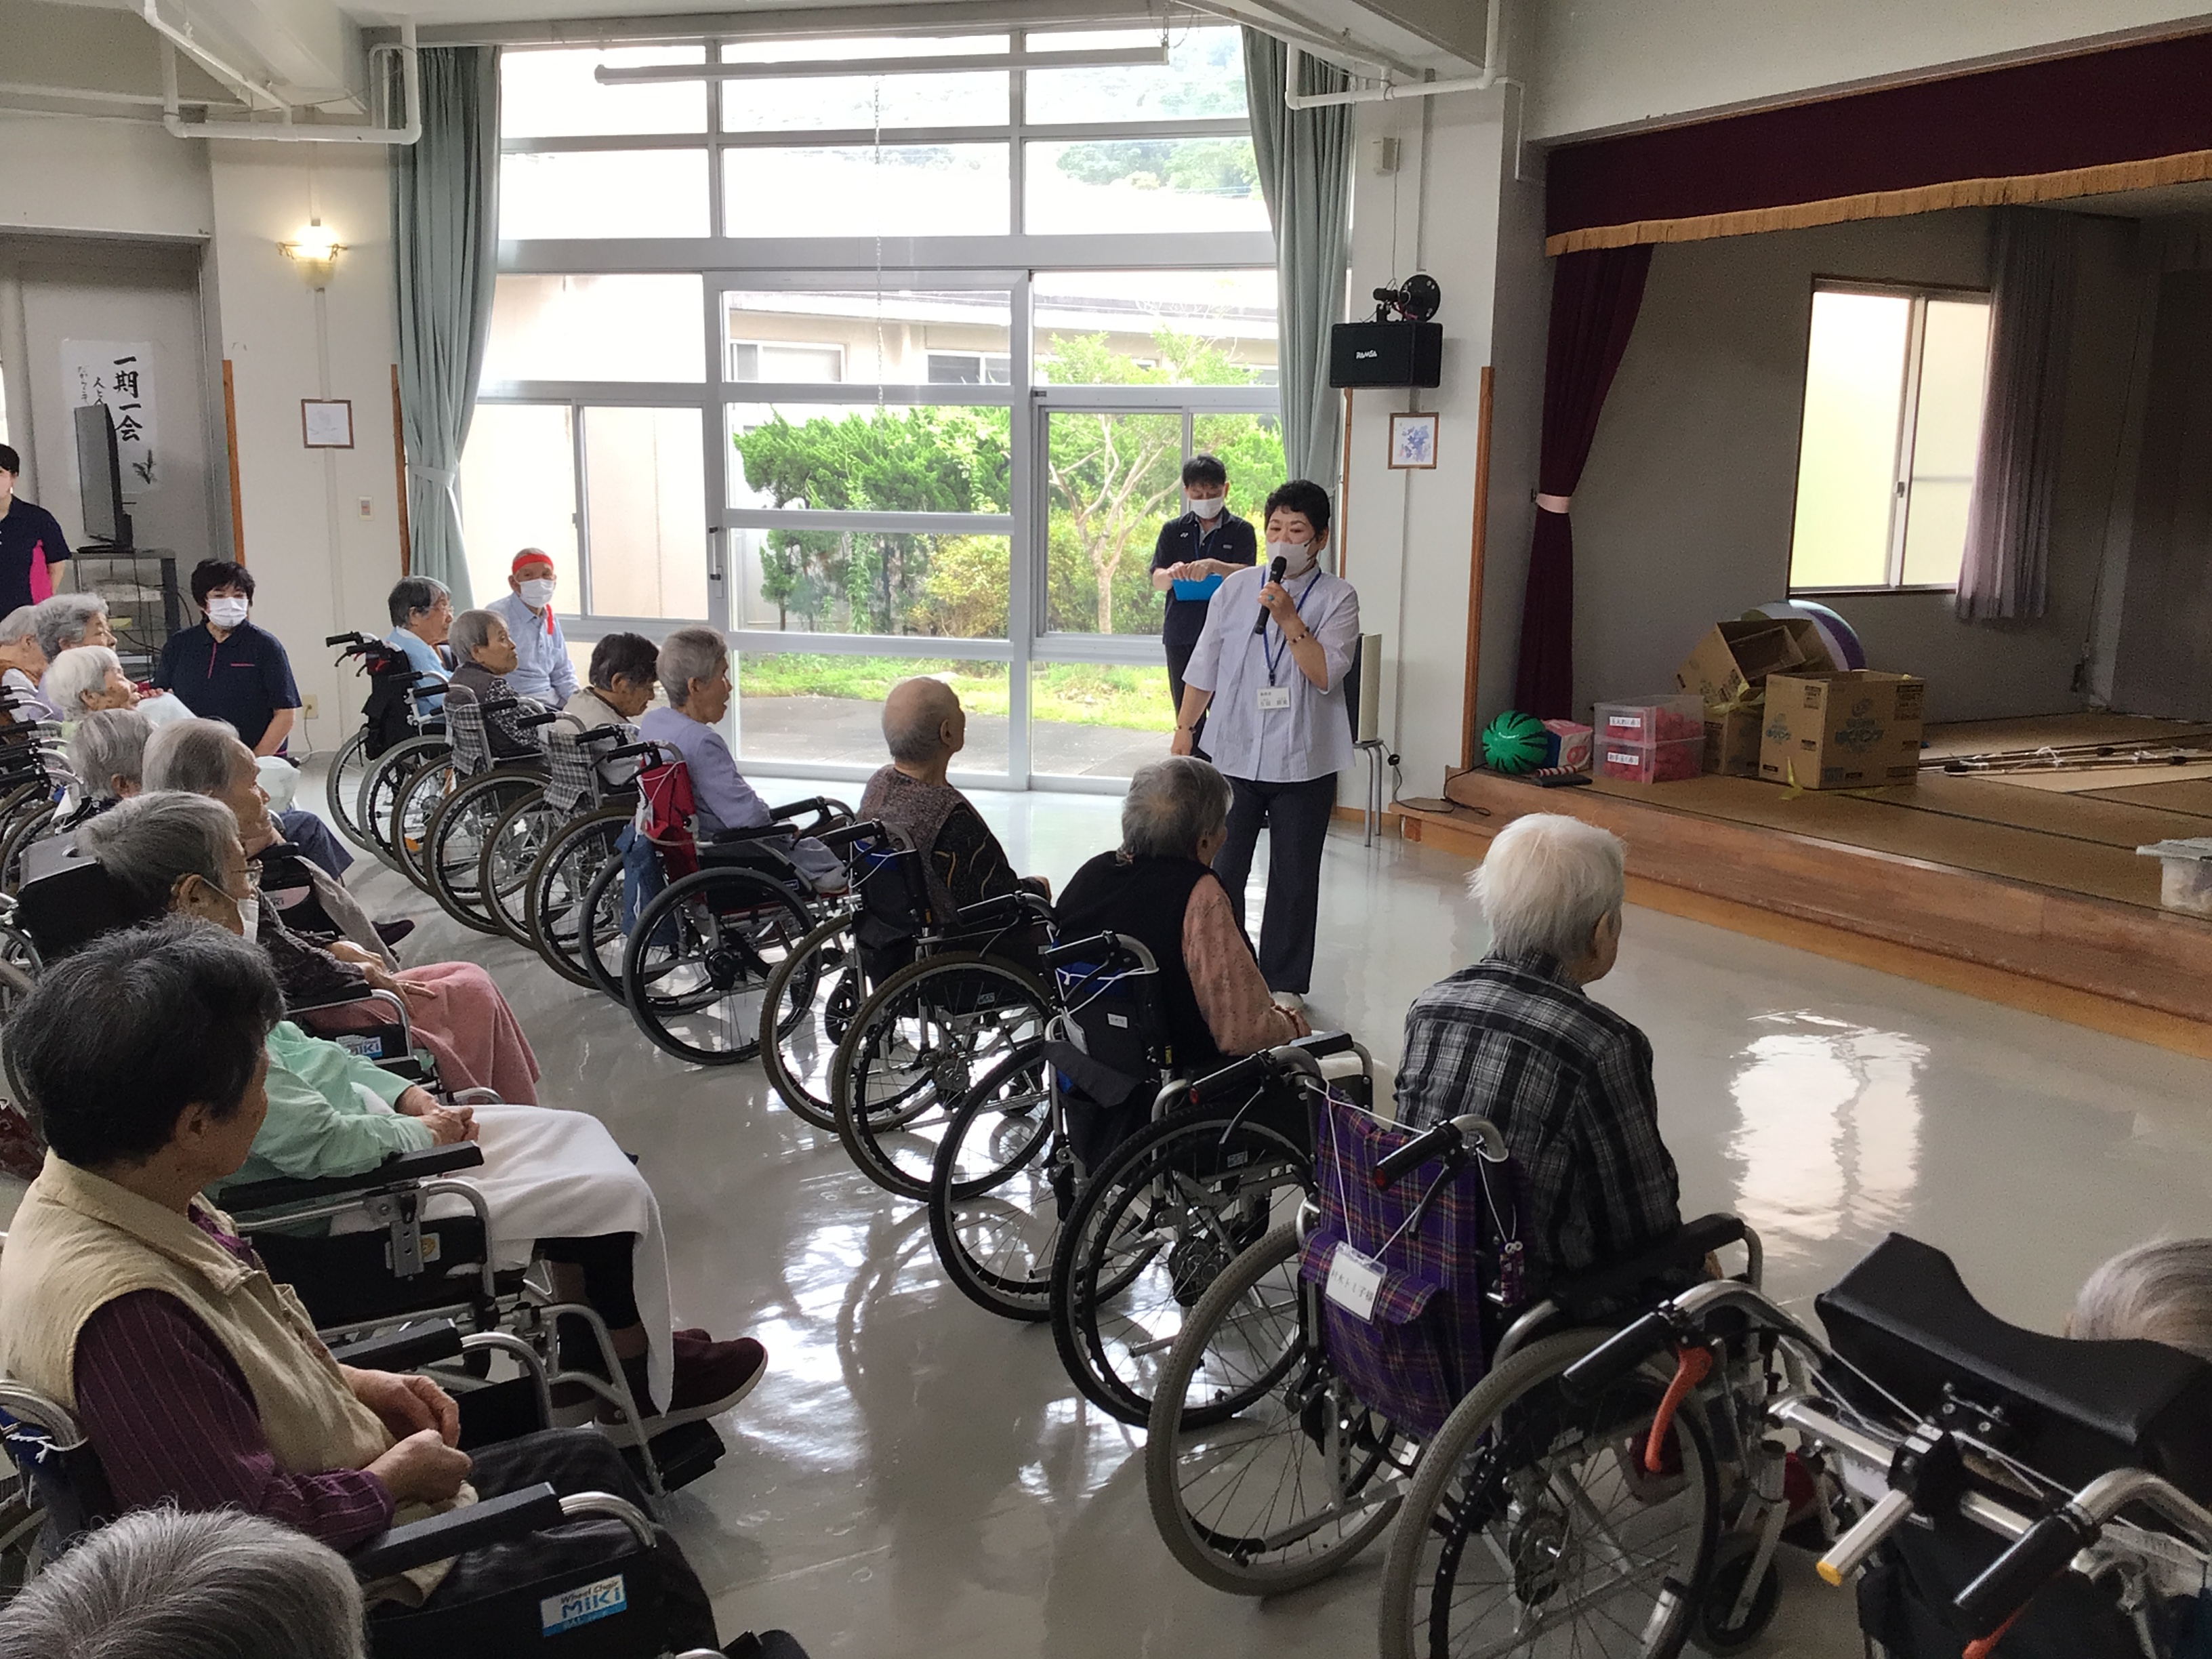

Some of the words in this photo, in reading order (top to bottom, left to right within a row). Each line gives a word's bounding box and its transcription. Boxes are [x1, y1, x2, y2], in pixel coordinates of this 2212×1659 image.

[1356, 350, 1378, 359] RAMSA
[112, 356, 143, 442] 一期一会
